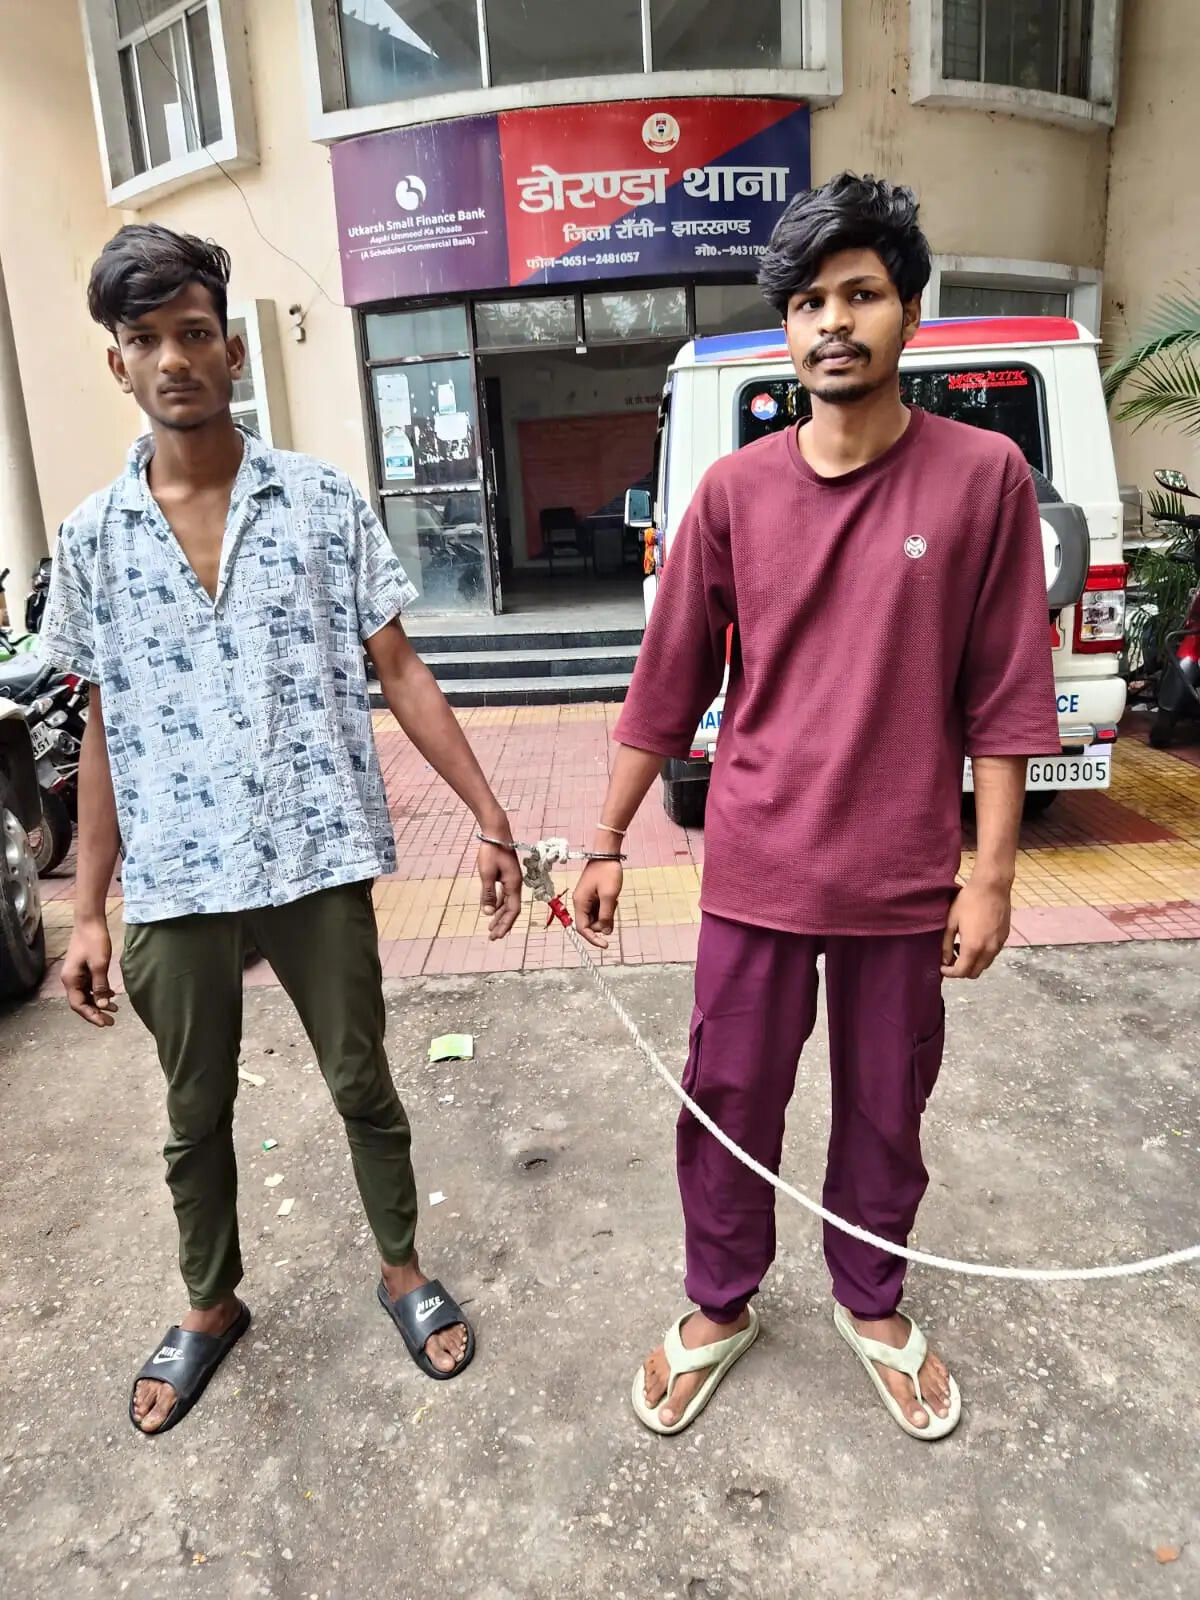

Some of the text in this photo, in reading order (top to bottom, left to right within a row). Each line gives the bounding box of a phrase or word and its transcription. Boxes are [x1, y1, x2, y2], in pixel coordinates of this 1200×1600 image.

[516, 164, 790, 213] डोरण्डा थाना
[348, 207, 486, 238] Utkarsh Small Finance Bank
[562, 223, 612, 243] जिला
[670, 219, 752, 238] झारखण्ड
[369, 245, 406, 258] Scheduled
[406, 238, 452, 252] Commercial
[452, 236, 475, 248] Bank)
[1029, 762, 1107, 783] GQ0305
[416, 1295, 441, 1313] NIKE
